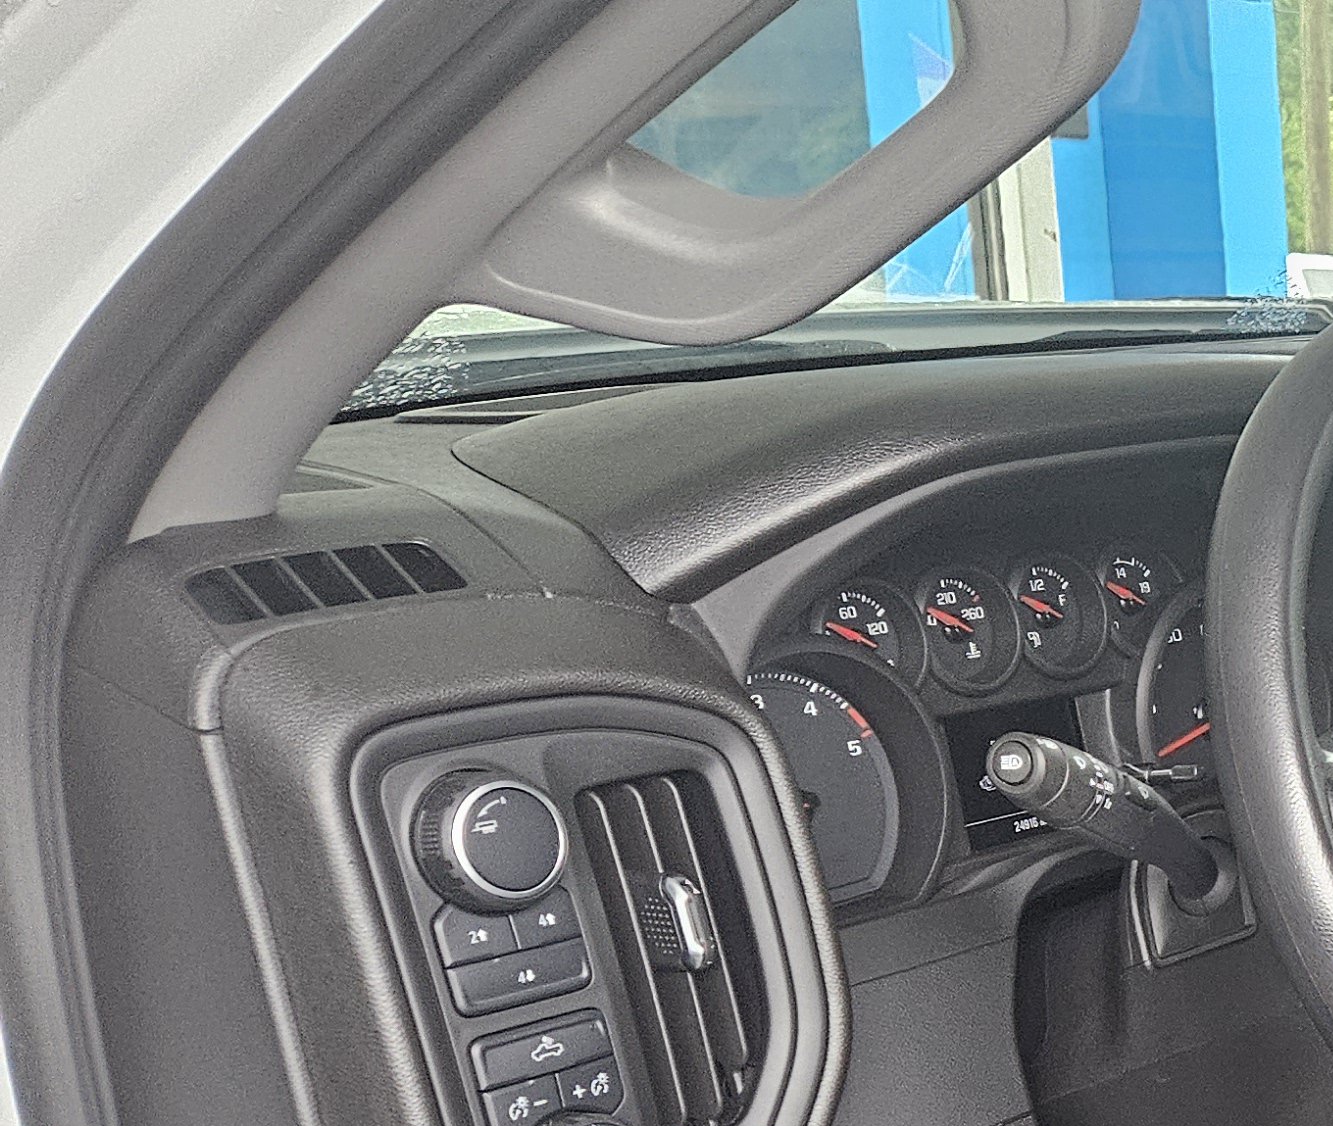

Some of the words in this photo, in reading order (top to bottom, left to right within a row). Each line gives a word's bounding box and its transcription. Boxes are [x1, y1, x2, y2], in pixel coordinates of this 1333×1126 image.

[1115, 567, 1127, 579] 14
[935, 591, 957, 606] 210
[1057, 593, 1067, 607] F
[838, 605, 858, 620] 60
[960, 606, 985, 621] 260
[866, 621, 889, 636] 120
[803, 701, 818, 716] 4
[847, 739, 862, 757] 5
